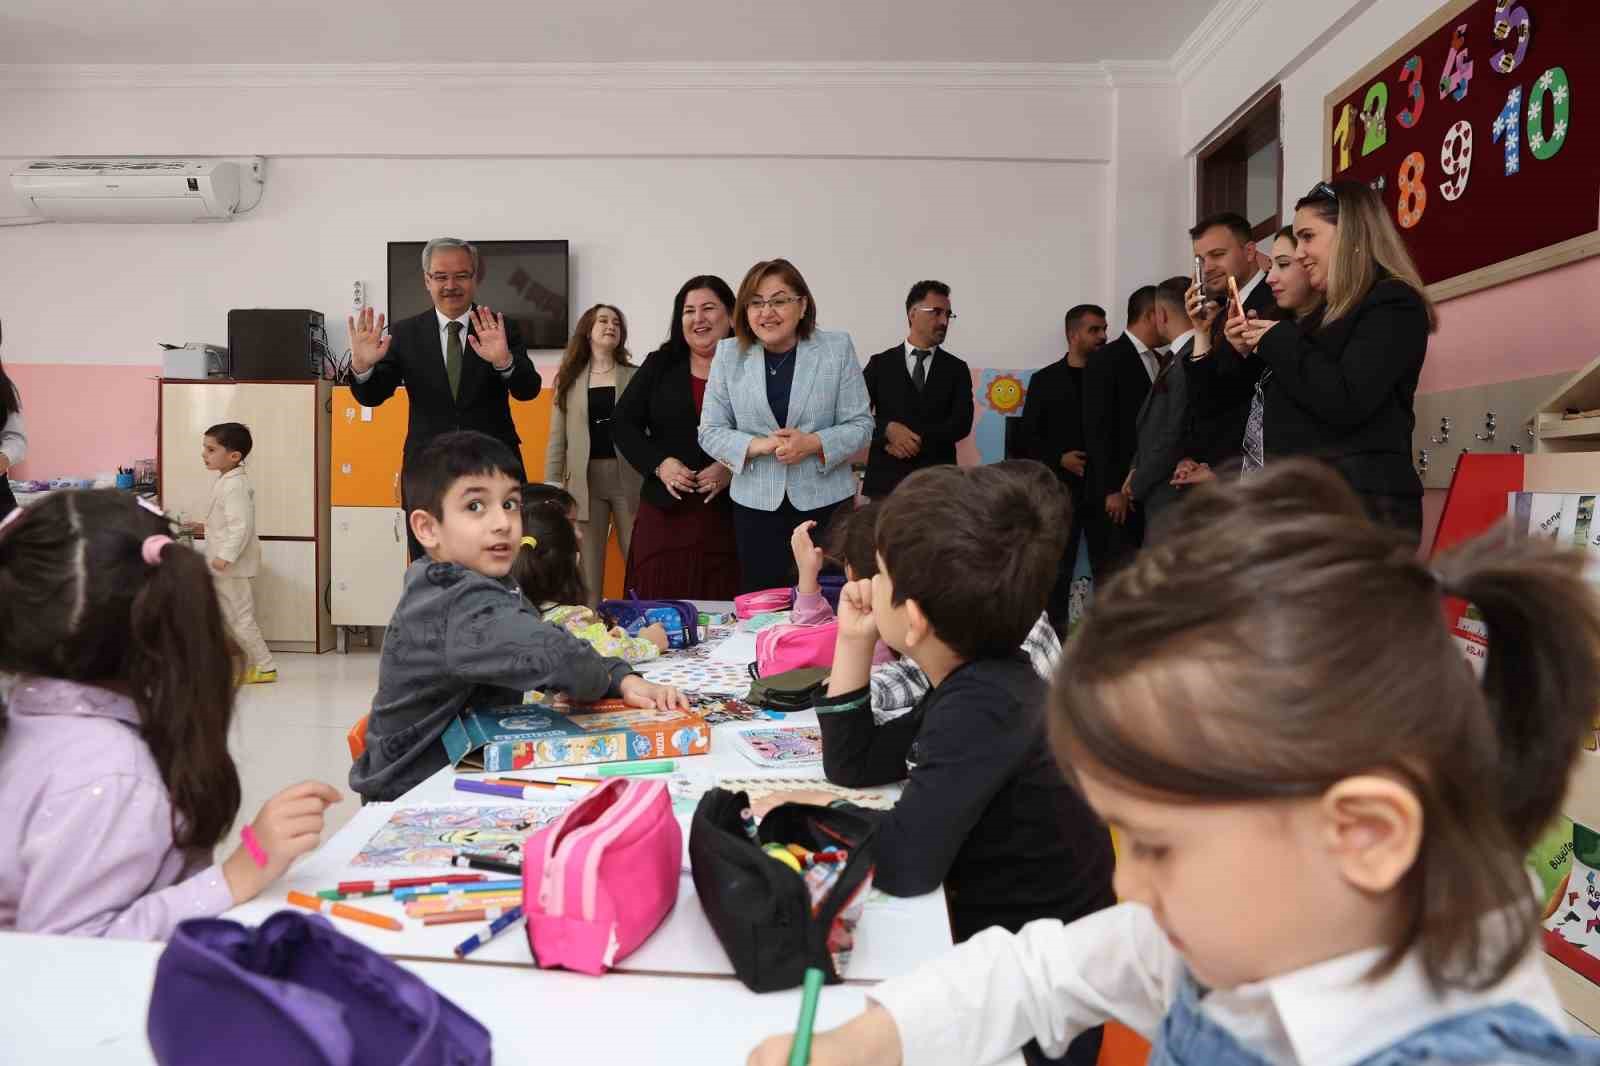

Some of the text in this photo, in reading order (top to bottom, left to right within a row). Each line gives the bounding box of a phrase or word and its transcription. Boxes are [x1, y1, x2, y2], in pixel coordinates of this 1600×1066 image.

[1334, 0, 1530, 173] 1 2 3 4 5
[1397, 66, 1569, 229] 8 9 10
